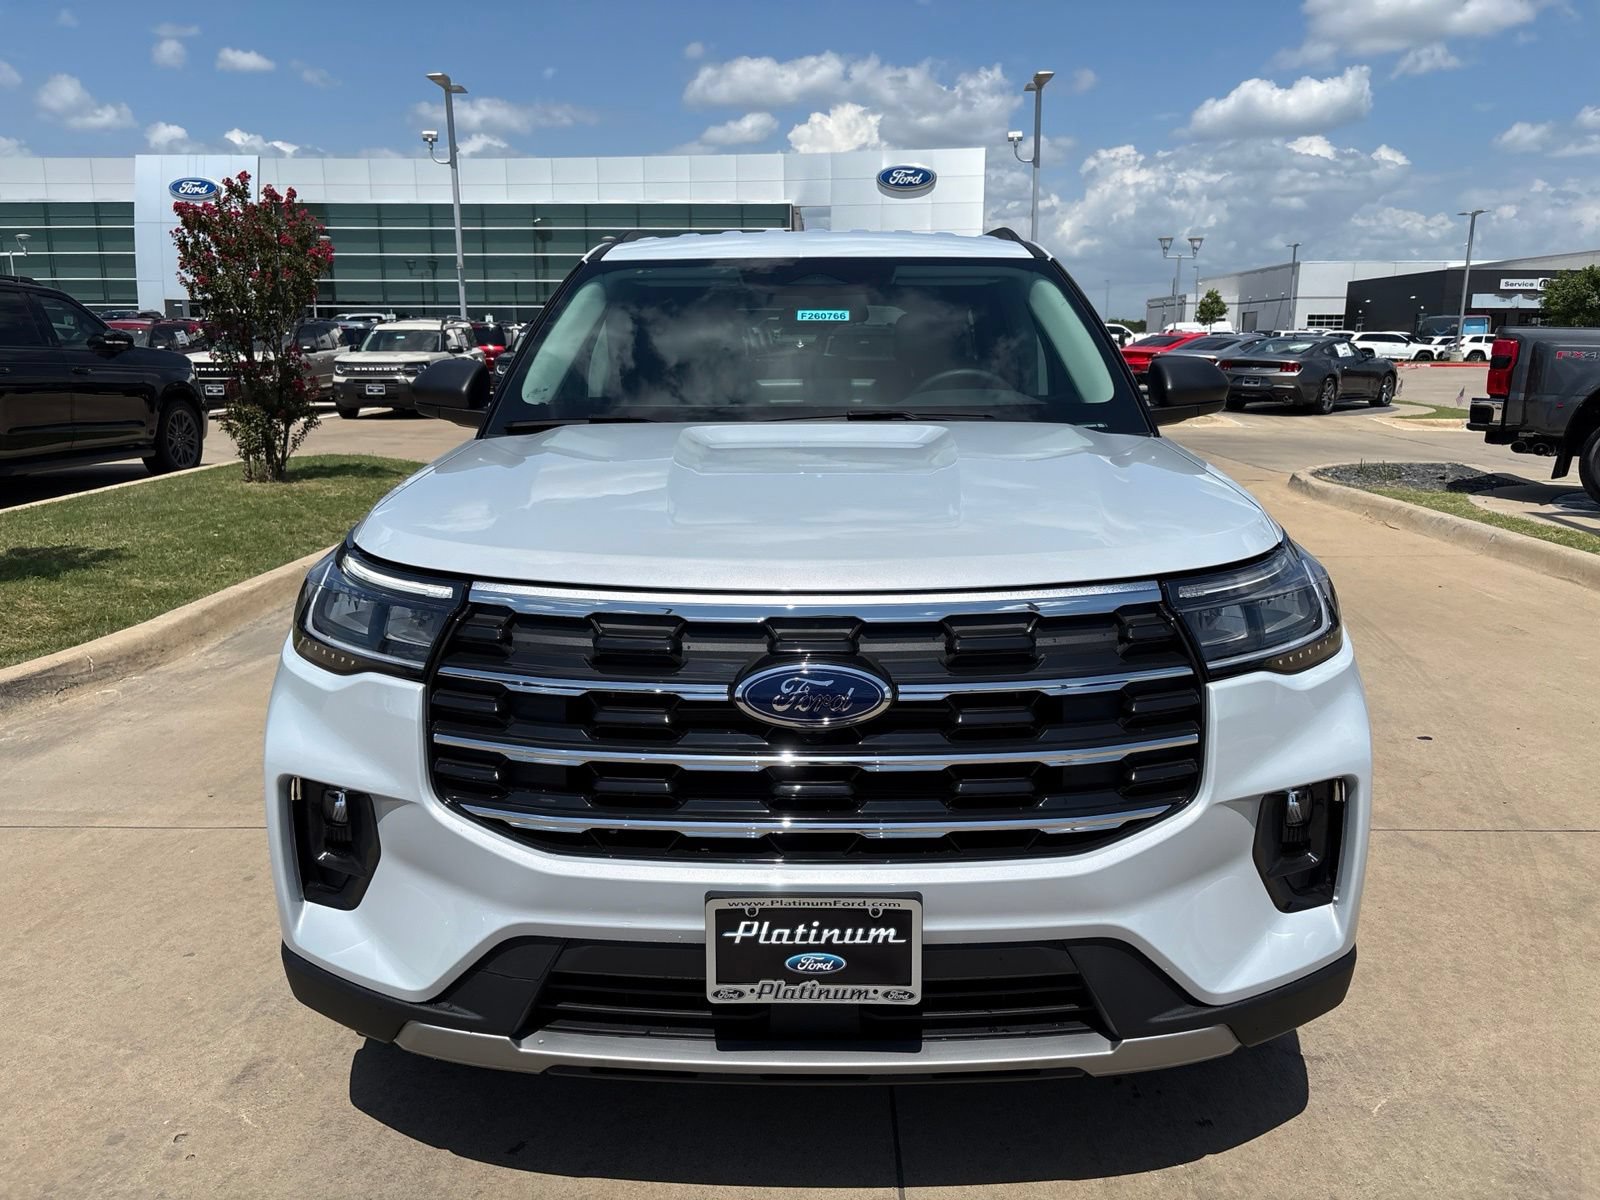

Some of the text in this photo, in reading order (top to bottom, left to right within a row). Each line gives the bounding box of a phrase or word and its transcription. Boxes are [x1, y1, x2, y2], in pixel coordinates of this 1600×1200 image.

[889, 169, 923, 184] Ford
[179, 181, 208, 194] Ford
[801, 312, 846, 320] F260766
[772, 677, 854, 712] Ford
[727, 900, 901, 908] www.PlatinumFord.com
[722, 921, 906, 944] Platinum
[797, 956, 833, 971] Ford
[717, 981, 910, 1000] Ford Platinum Ford
